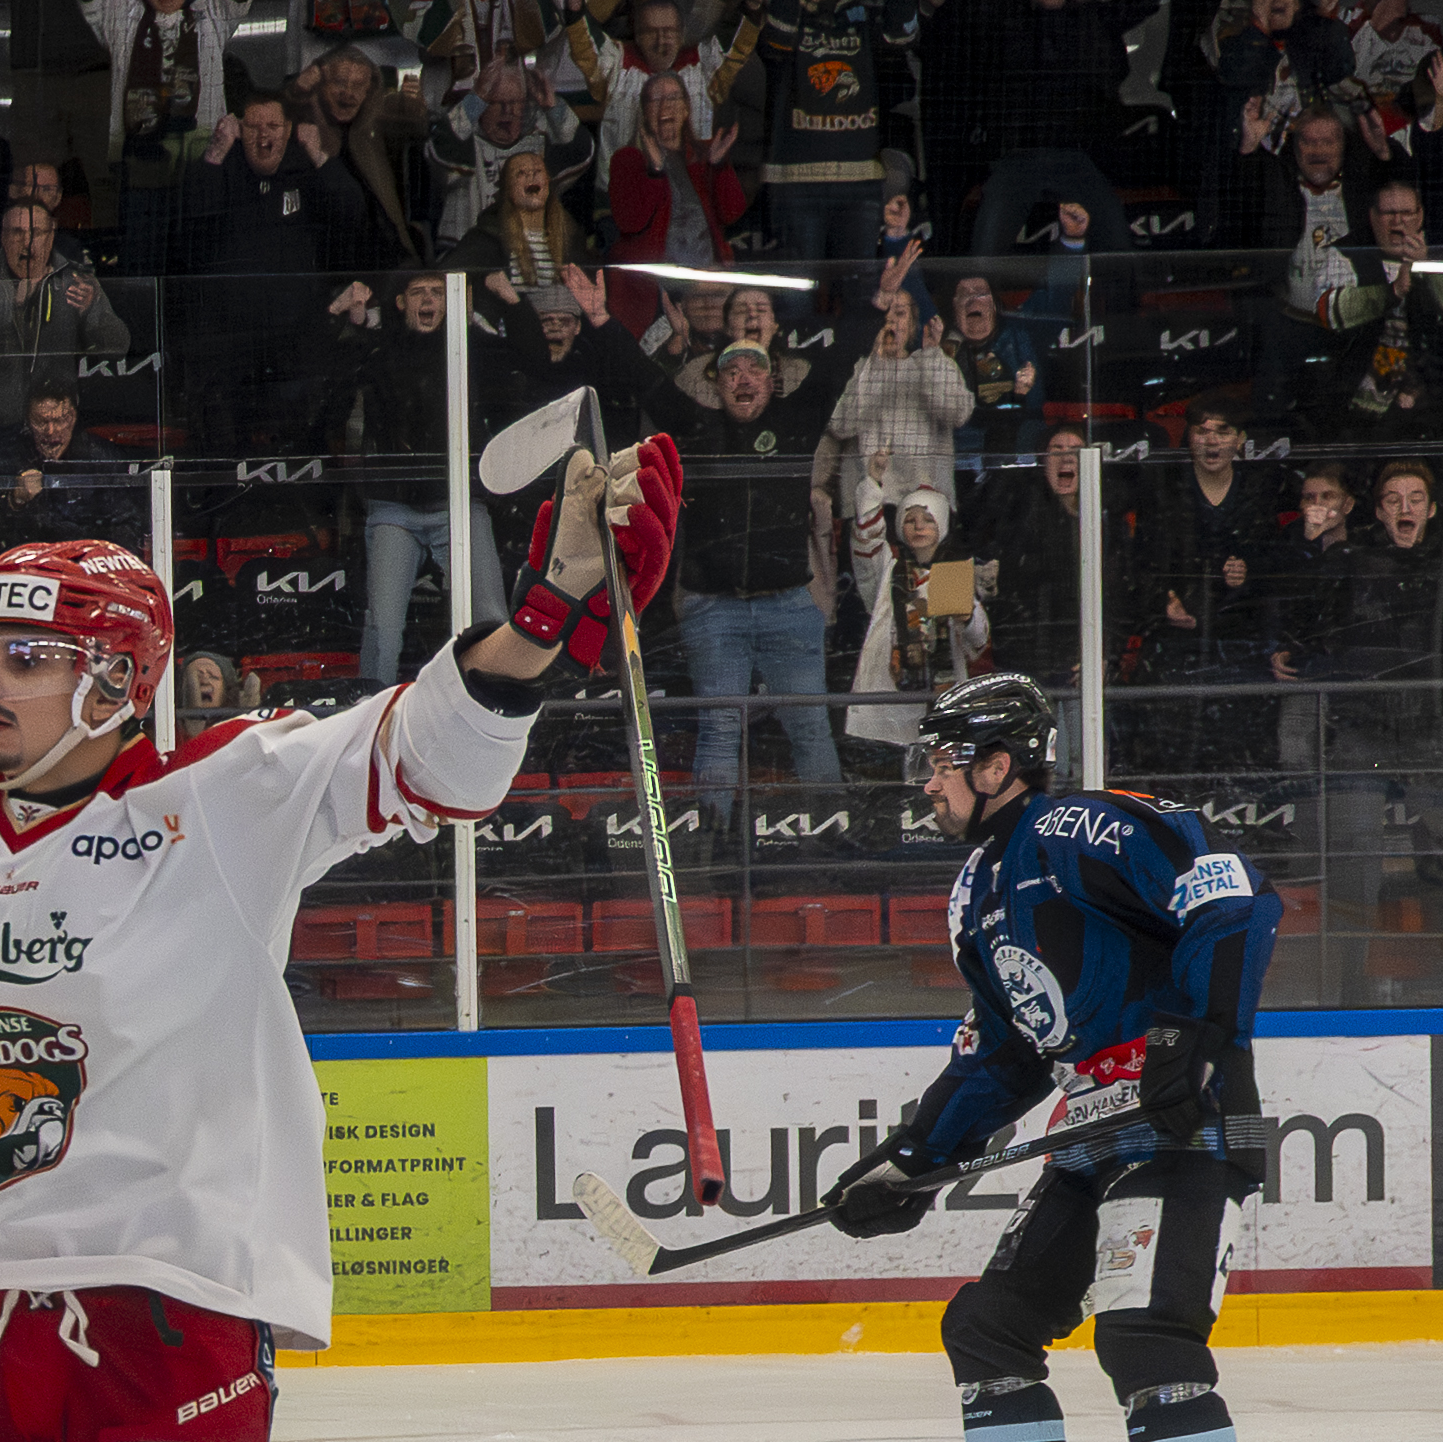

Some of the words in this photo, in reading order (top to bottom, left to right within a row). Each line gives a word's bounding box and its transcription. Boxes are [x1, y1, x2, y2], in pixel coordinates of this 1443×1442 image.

[1034, 806, 1121, 855] ABENA
[364, 1123, 436, 1139] DESIGN
[361, 1193, 375, 1207] &
[381, 1192, 430, 1208] FLAG
[177, 1371, 262, 1427] BAUER
